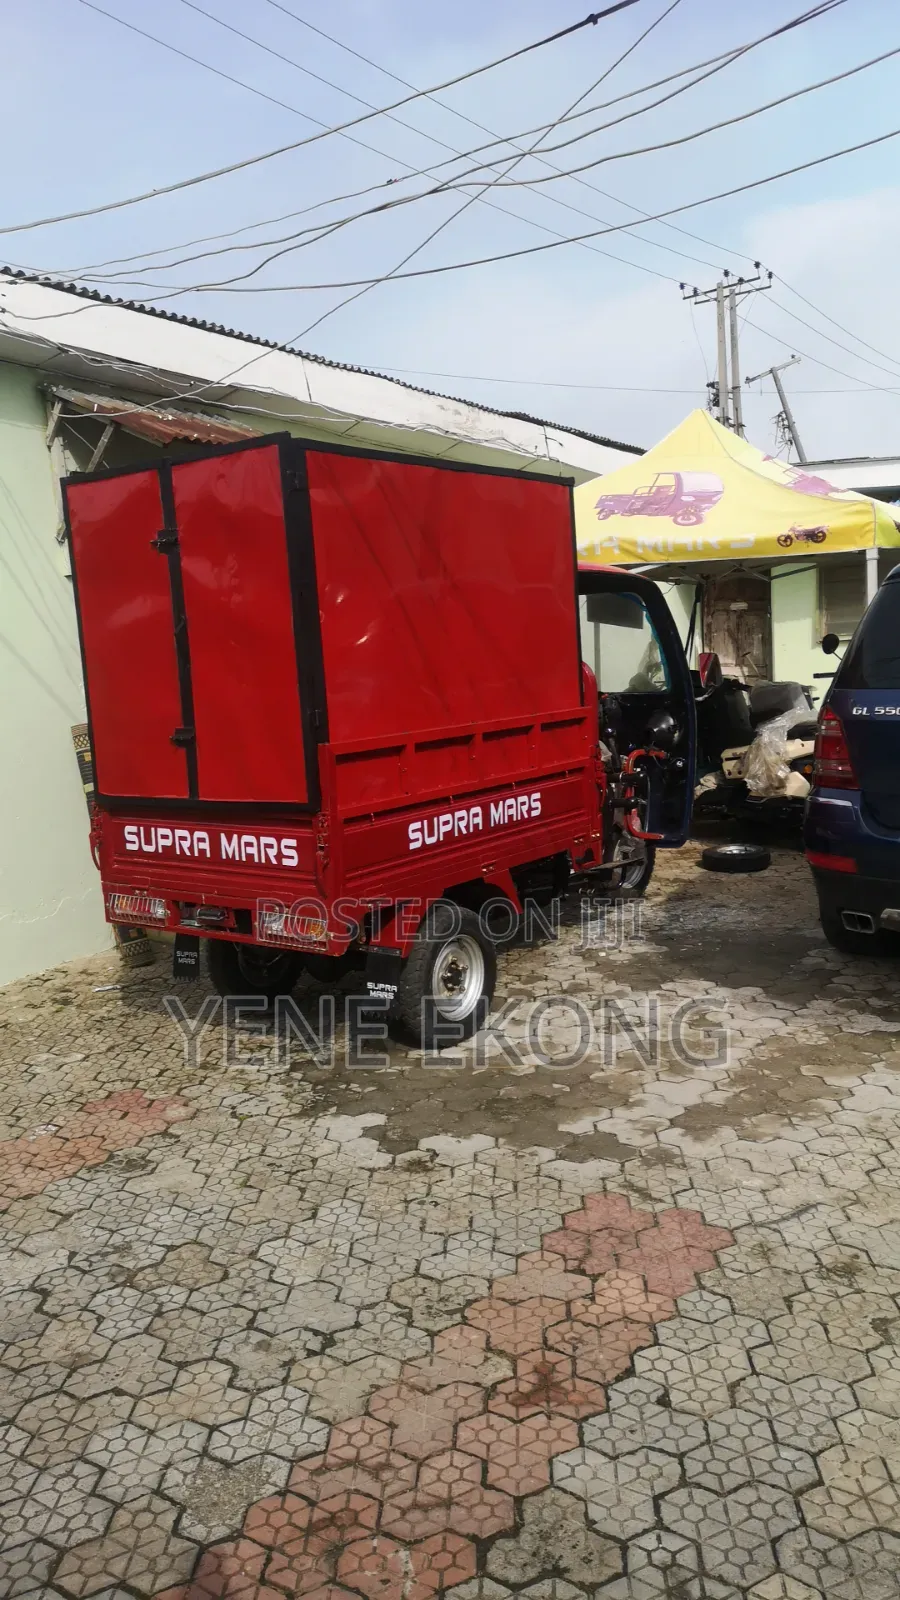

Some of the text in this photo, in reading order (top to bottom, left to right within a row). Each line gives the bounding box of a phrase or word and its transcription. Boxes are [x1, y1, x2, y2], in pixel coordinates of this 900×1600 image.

[852, 706, 870, 716] GL
[407, 792, 542, 850] SUPRA MARS
[123, 825, 299, 867] SUPRA MARS
[366, 981, 398, 993] SUPRA
[369, 990, 395, 1000] MARS
